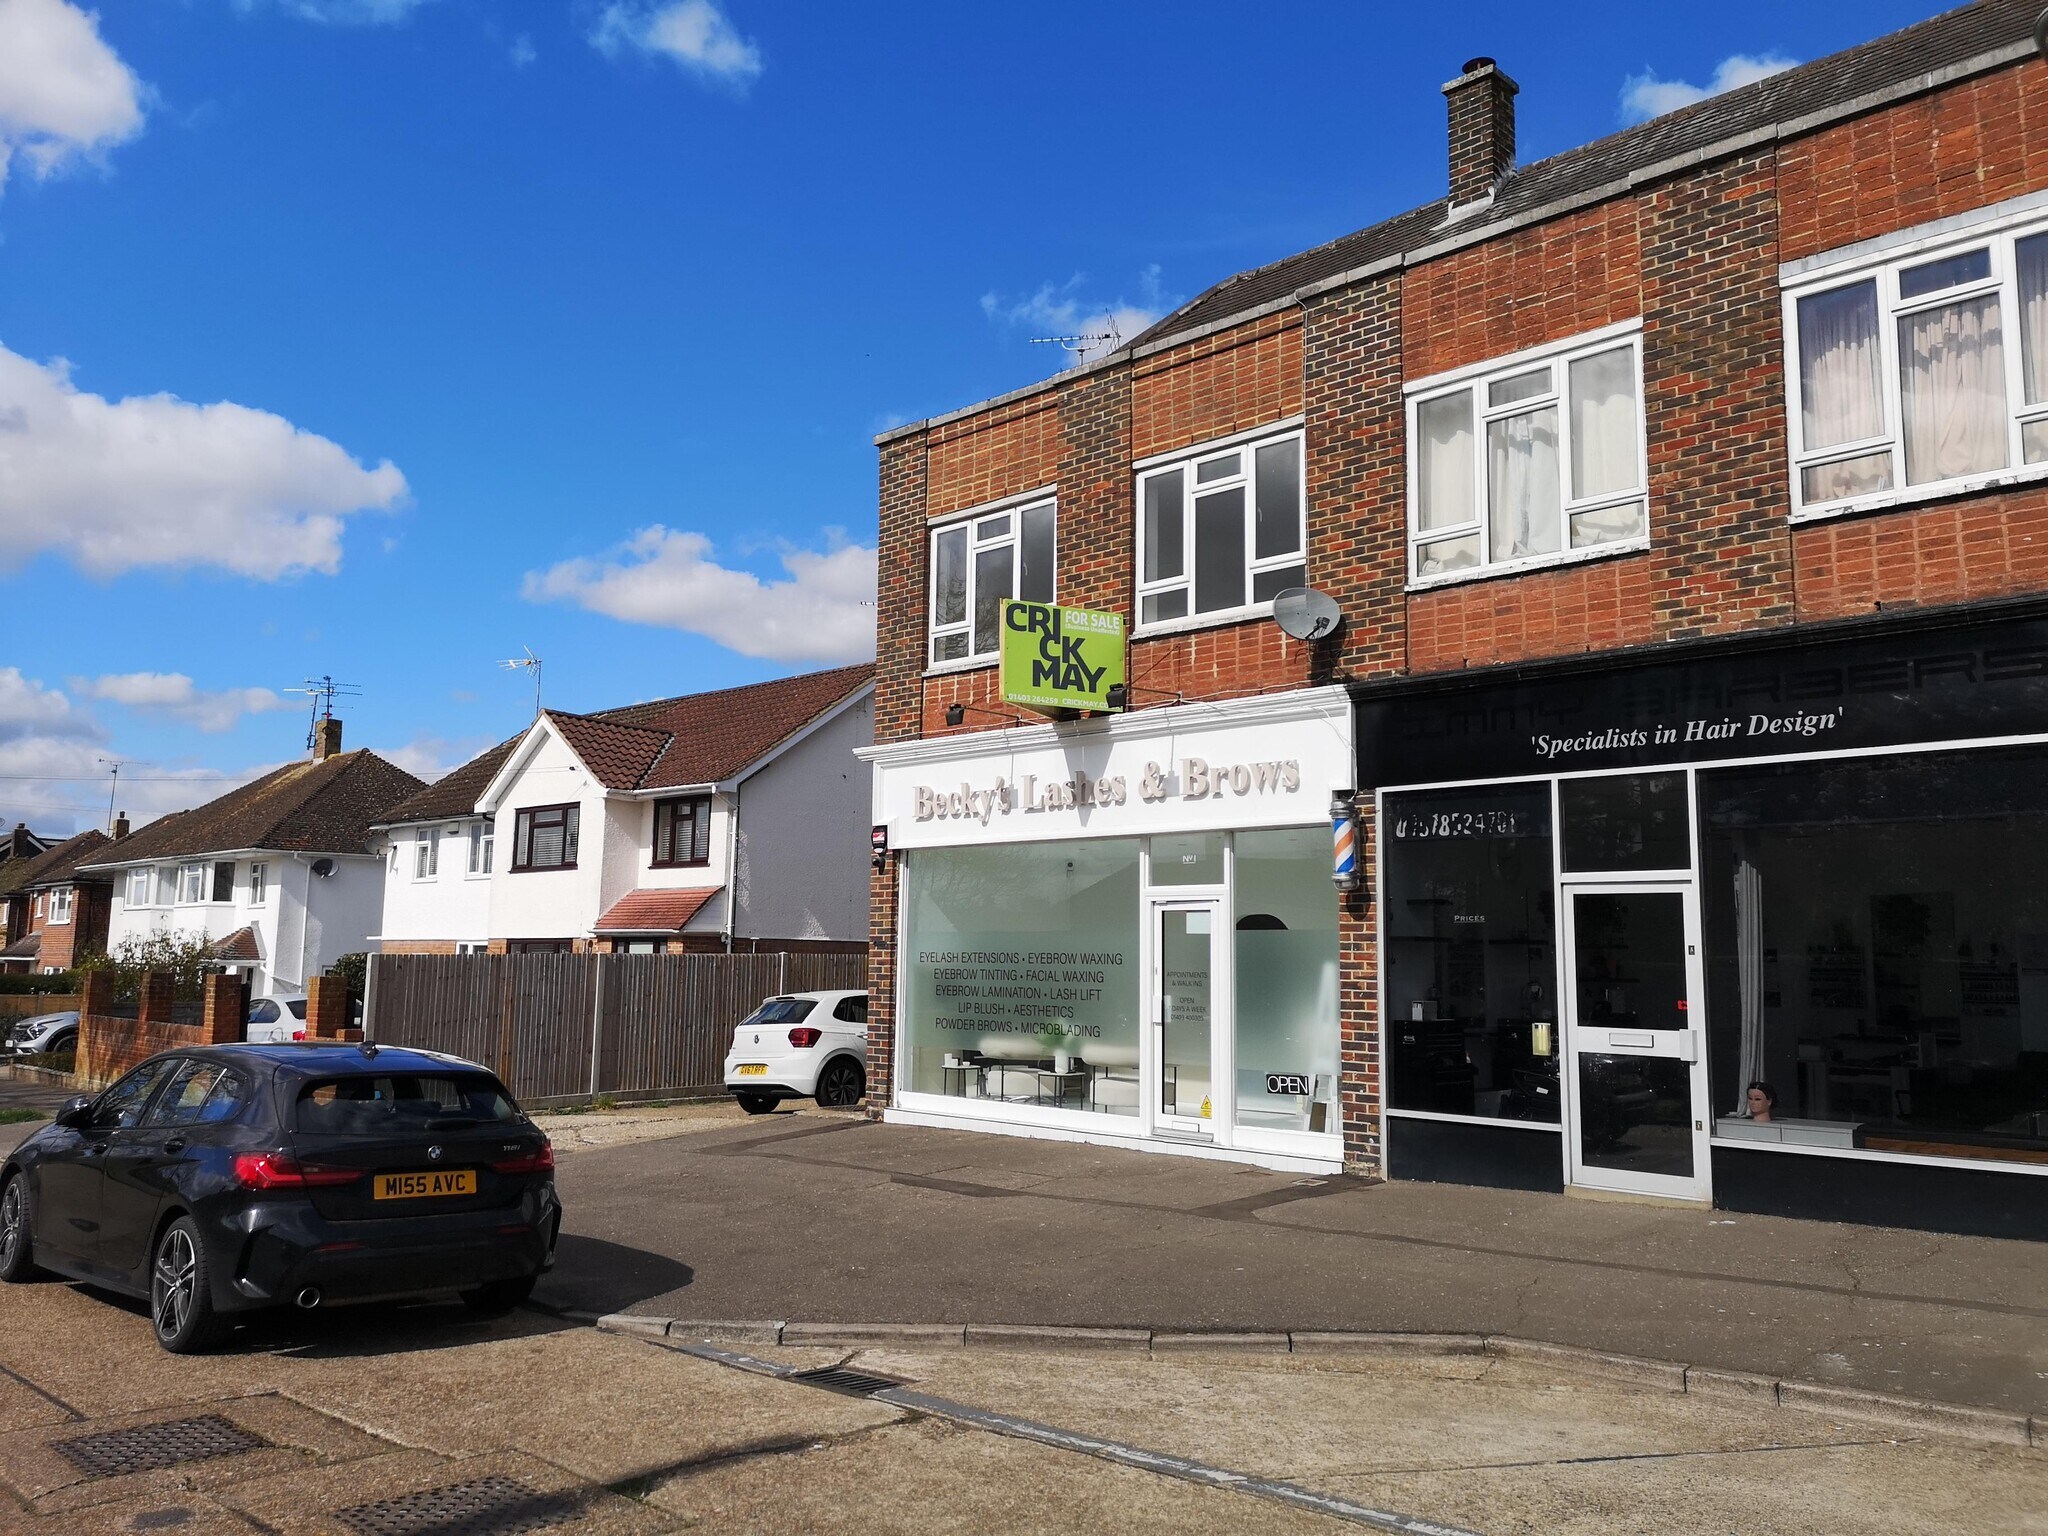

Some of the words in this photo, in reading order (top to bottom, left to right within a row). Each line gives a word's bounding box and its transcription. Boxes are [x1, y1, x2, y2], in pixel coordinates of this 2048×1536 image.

[1065, 610, 1088, 626] FOR
[1091, 614, 1120, 630] SALE
[1033, 659, 1107, 694] MAY
[1008, 693, 1031, 702] 01403
[1531, 728, 1648, 758] 'Specialists
[1654, 724, 1677, 744] in
[1684, 717, 1742, 742] Hair
[1746, 706, 1844, 737] Design'
[912, 776, 1011, 825] Becky's
[1020, 770, 1126, 809] Lashes
[1138, 760, 1166, 800] &
[1179, 757, 1300, 798] Brows
[919, 951, 959, 963] EYELASH
[961, 952, 1020, 964] EXTENSIONS
[1028, 952, 1077, 965] EYEBROW
[1080, 953, 1123, 965] WAXING
[934, 968, 978, 980] EYEBROW
[980, 969, 1018, 981] TINTING
[1026, 970, 1060, 982] FACIAL
[1062, 971, 1104, 983] WAXING
[1167, 971, 1208, 979] APPOINTMENTS
[935, 985, 979, 997] EYEBROW
[982, 986, 1041, 999] LAMINATION
[1050, 988, 1077, 1000] LASH
[1080, 989, 1102, 1001] LIFT
[958, 1003, 972, 1014] LIP
[974, 1003, 1005, 1015] BLUSH
[1013, 1004, 1074, 1018] AESTHETICS
[935, 1018, 975, 1031] POWDER
[977, 1019, 1013, 1032] BROWS
[1020, 1023, 1101, 1038] MICROBLADING
[1267, 1075, 1309, 1095] OPEN
[433, 1174, 466, 1193] AVC
